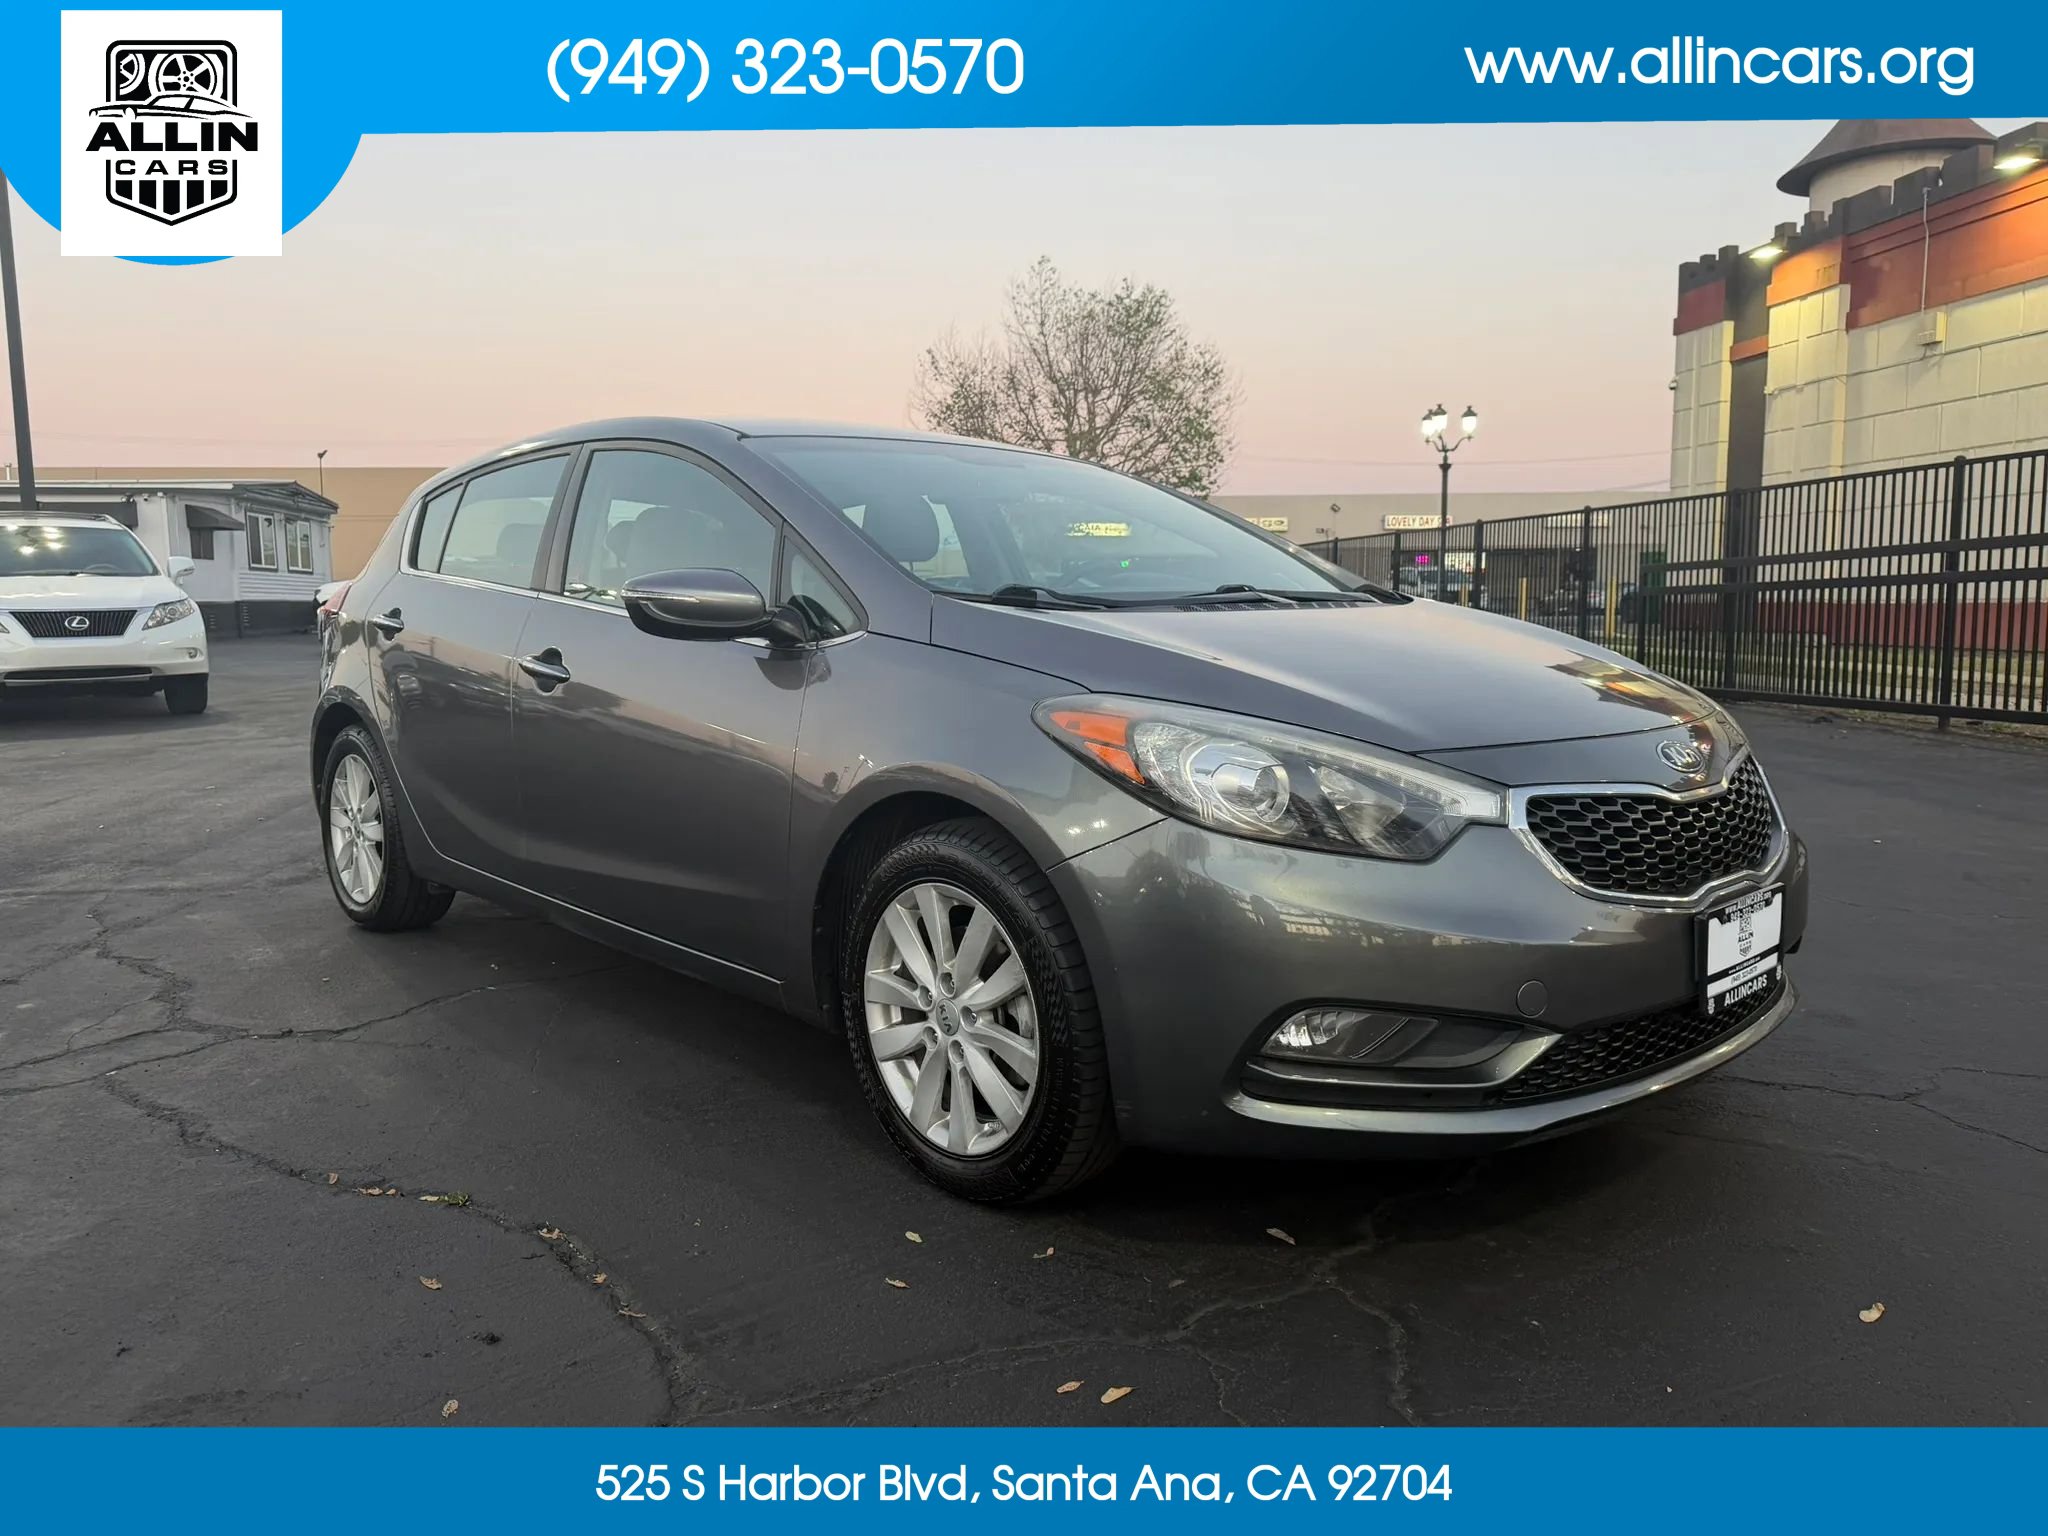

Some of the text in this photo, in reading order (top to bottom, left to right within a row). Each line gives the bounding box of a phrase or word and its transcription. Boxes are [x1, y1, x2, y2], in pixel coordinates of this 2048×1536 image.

[1386, 516, 1417, 527] LOVELY
[1419, 516, 1435, 527] DAY
[1724, 973, 1768, 1007] ALLINCARS
[938, 1004, 952, 1032] KIA
